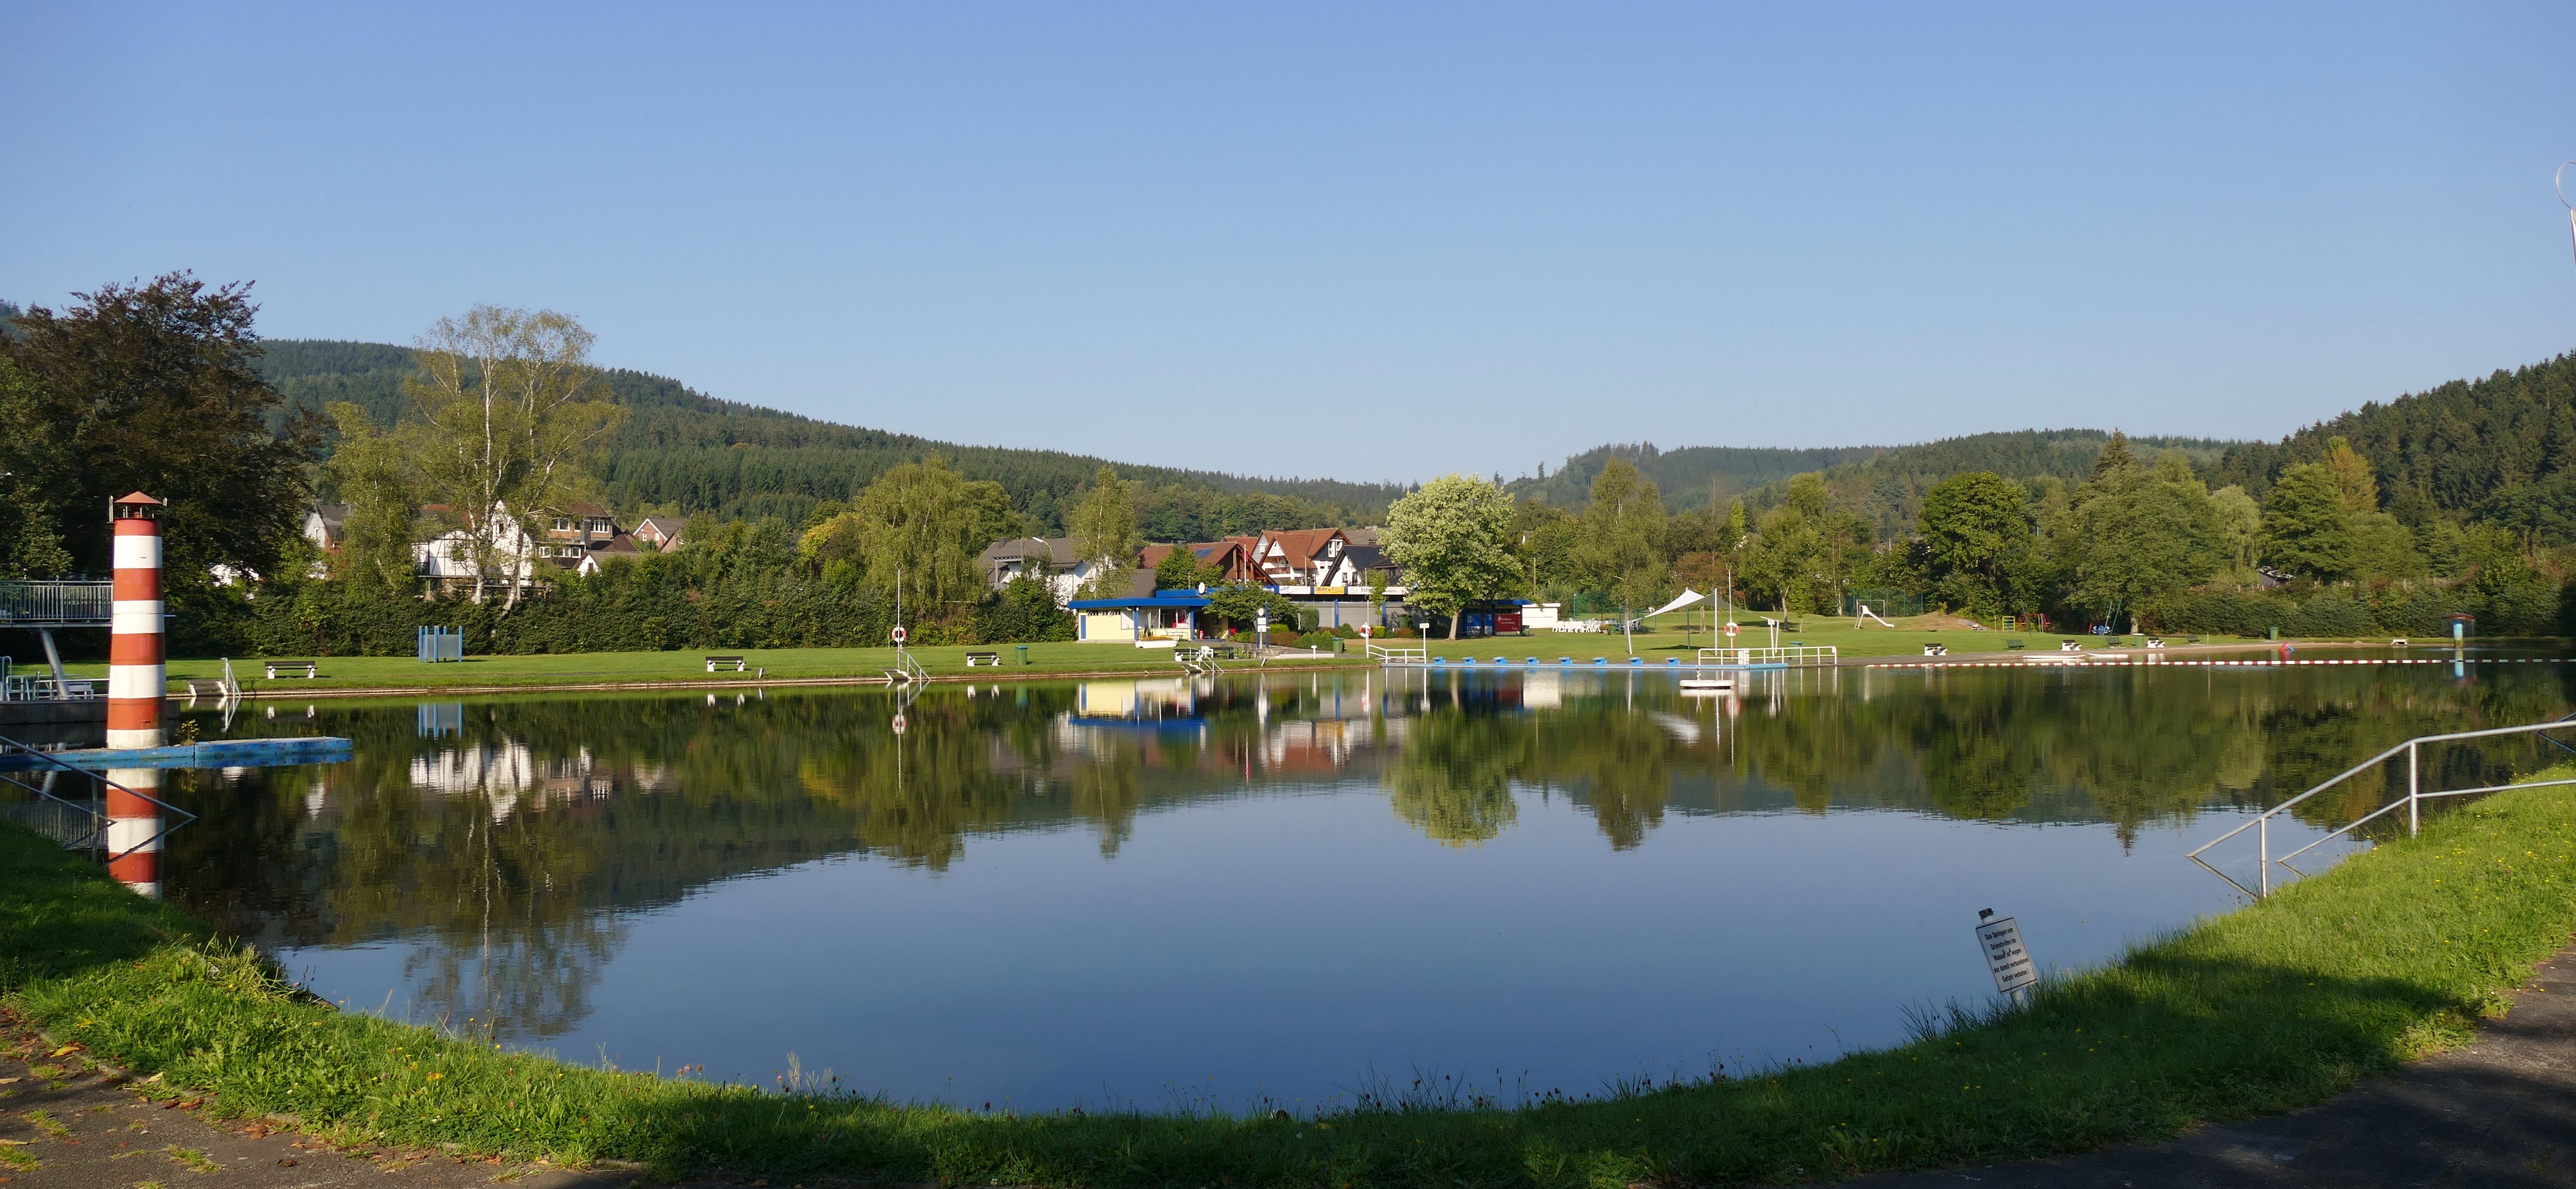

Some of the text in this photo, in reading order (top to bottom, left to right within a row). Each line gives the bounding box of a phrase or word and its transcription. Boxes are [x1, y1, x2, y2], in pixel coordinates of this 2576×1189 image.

[1992, 930, 2007, 938] Springen
[2000, 963, 2010, 971] damit
[2010, 958, 2029, 967] verbundenen
[2002, 974, 2014, 982] Gefahr
